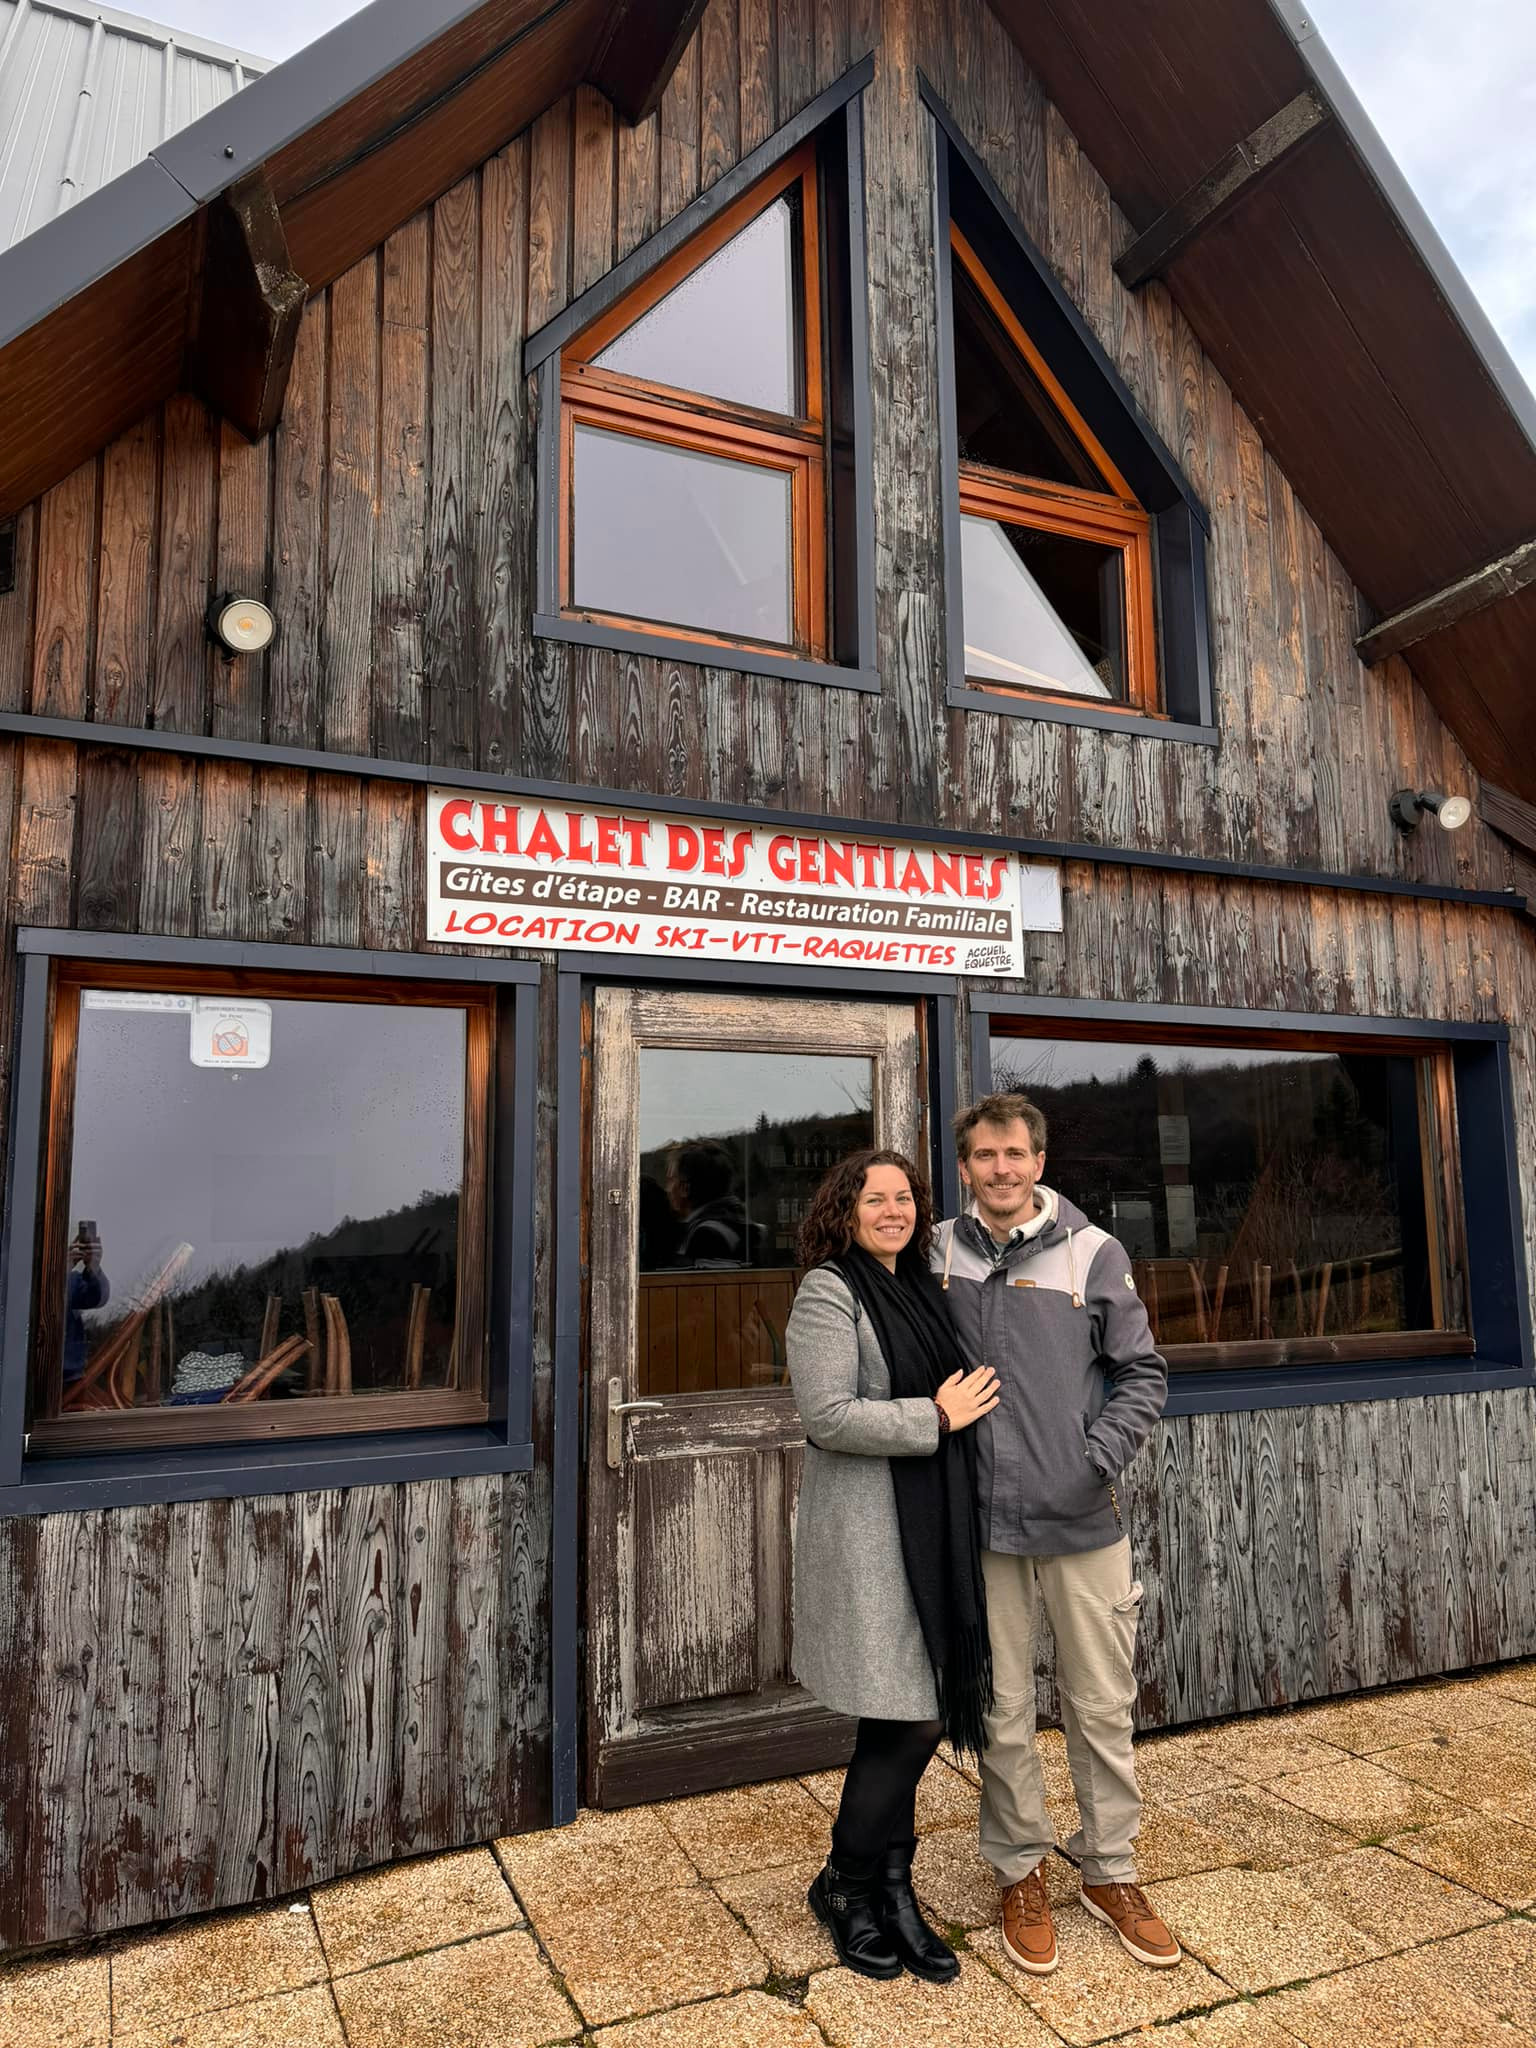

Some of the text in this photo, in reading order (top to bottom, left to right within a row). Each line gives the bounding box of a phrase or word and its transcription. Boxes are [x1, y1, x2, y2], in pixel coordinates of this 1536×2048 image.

[439, 799, 1008, 901] CHALET DES GENTIANES
[445, 867, 525, 896] Gîtes
[532, 874, 641, 909] d'étape
[663, 886, 721, 912] BAR
[740, 892, 900, 926] Restauration
[904, 906, 1008, 934] Familiale
[445, 910, 641, 945] LOCATION
[967, 945, 1006, 959] ACCUEIL
